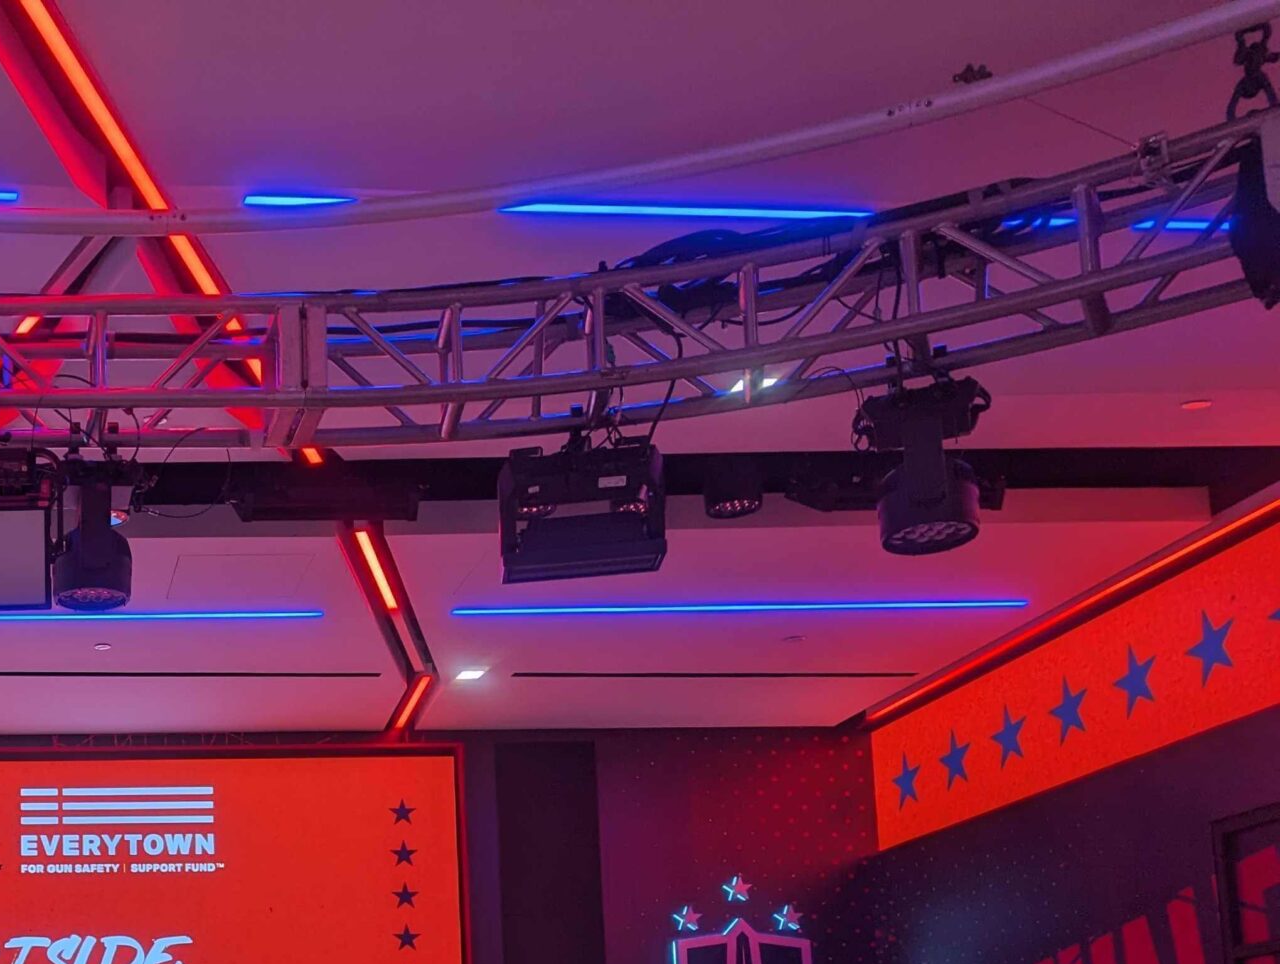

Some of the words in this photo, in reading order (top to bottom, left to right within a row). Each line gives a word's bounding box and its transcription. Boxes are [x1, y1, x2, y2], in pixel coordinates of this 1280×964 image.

[21, 833, 216, 856] EVERYTOWN
[21, 864, 44, 873] FOR
[47, 864, 72, 873] GUN
[74, 863, 120, 873] SAFETY
[130, 863, 183, 873] SUPPORT
